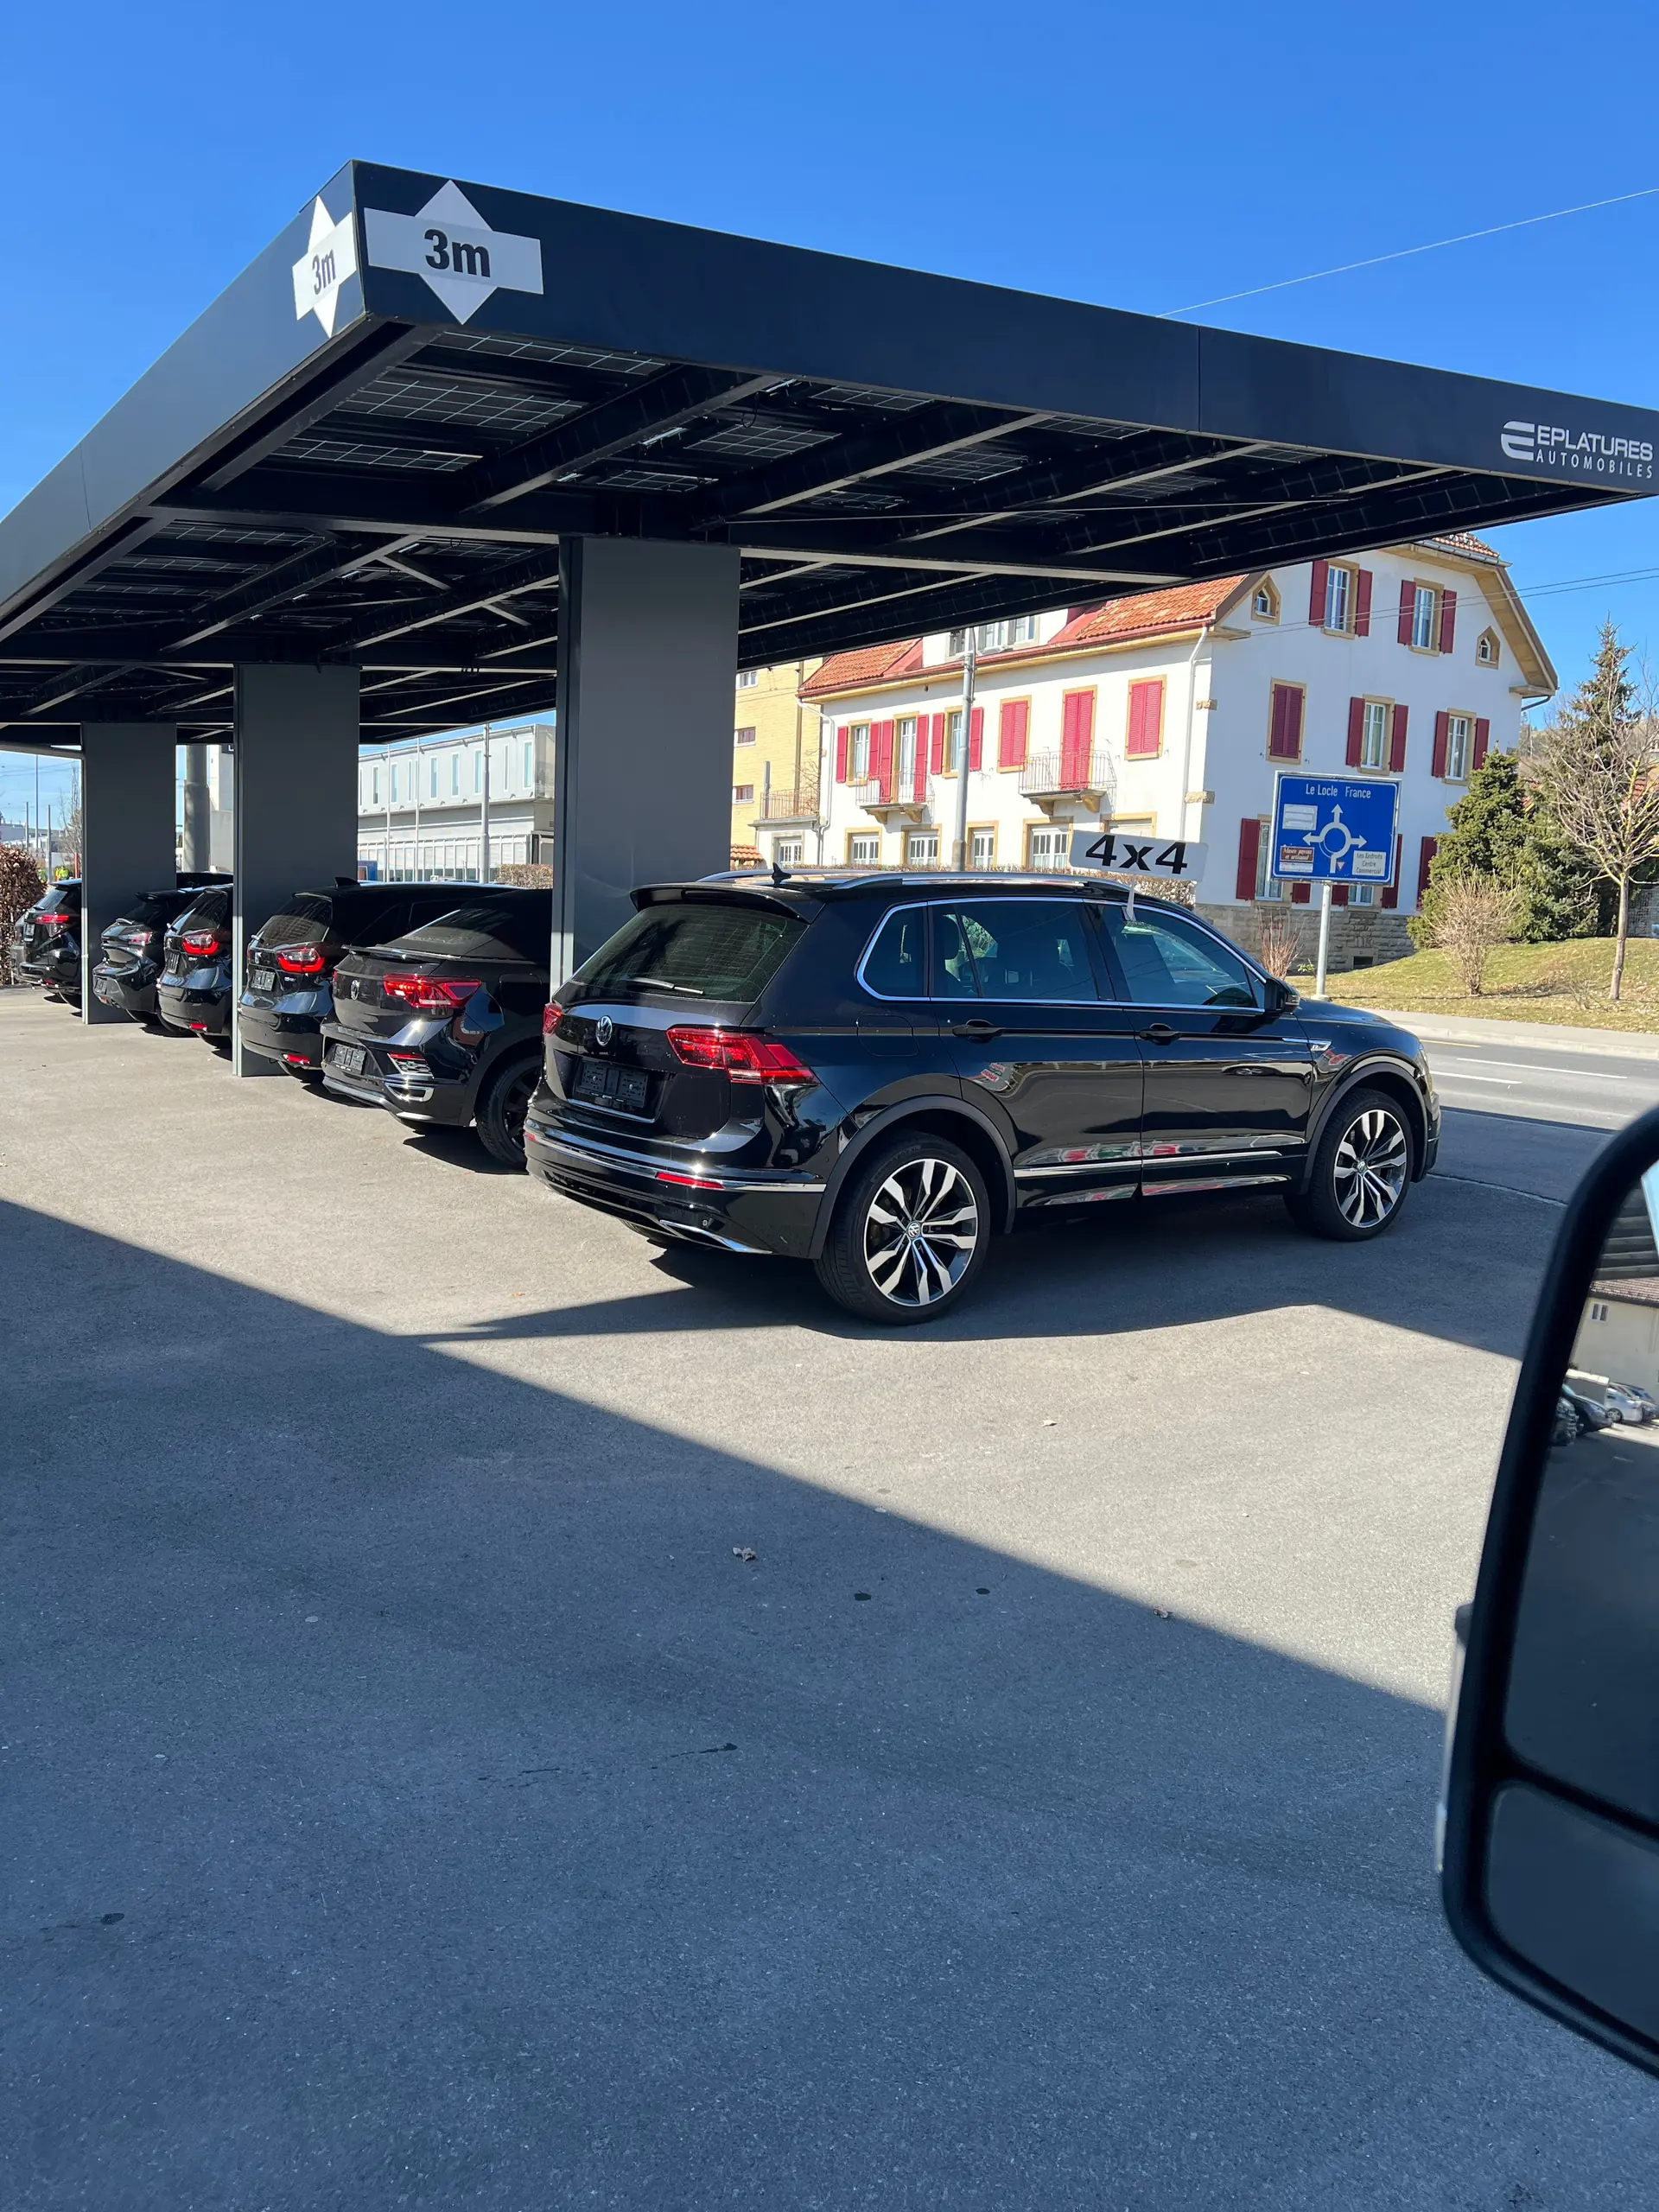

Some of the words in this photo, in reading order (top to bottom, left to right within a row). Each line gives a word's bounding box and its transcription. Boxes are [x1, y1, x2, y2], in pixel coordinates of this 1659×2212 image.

[311, 249, 337, 296] 3m
[423, 228, 491, 278] 3m
[1536, 424, 1654, 461] EPLATURES
[1535, 448, 1653, 479] AUTOMOBILES
[1306, 783, 1315, 795] Le
[1318, 784, 1338, 797] Locle
[1344, 785, 1371, 798] France
[1085, 834, 1188, 875] 4x4
